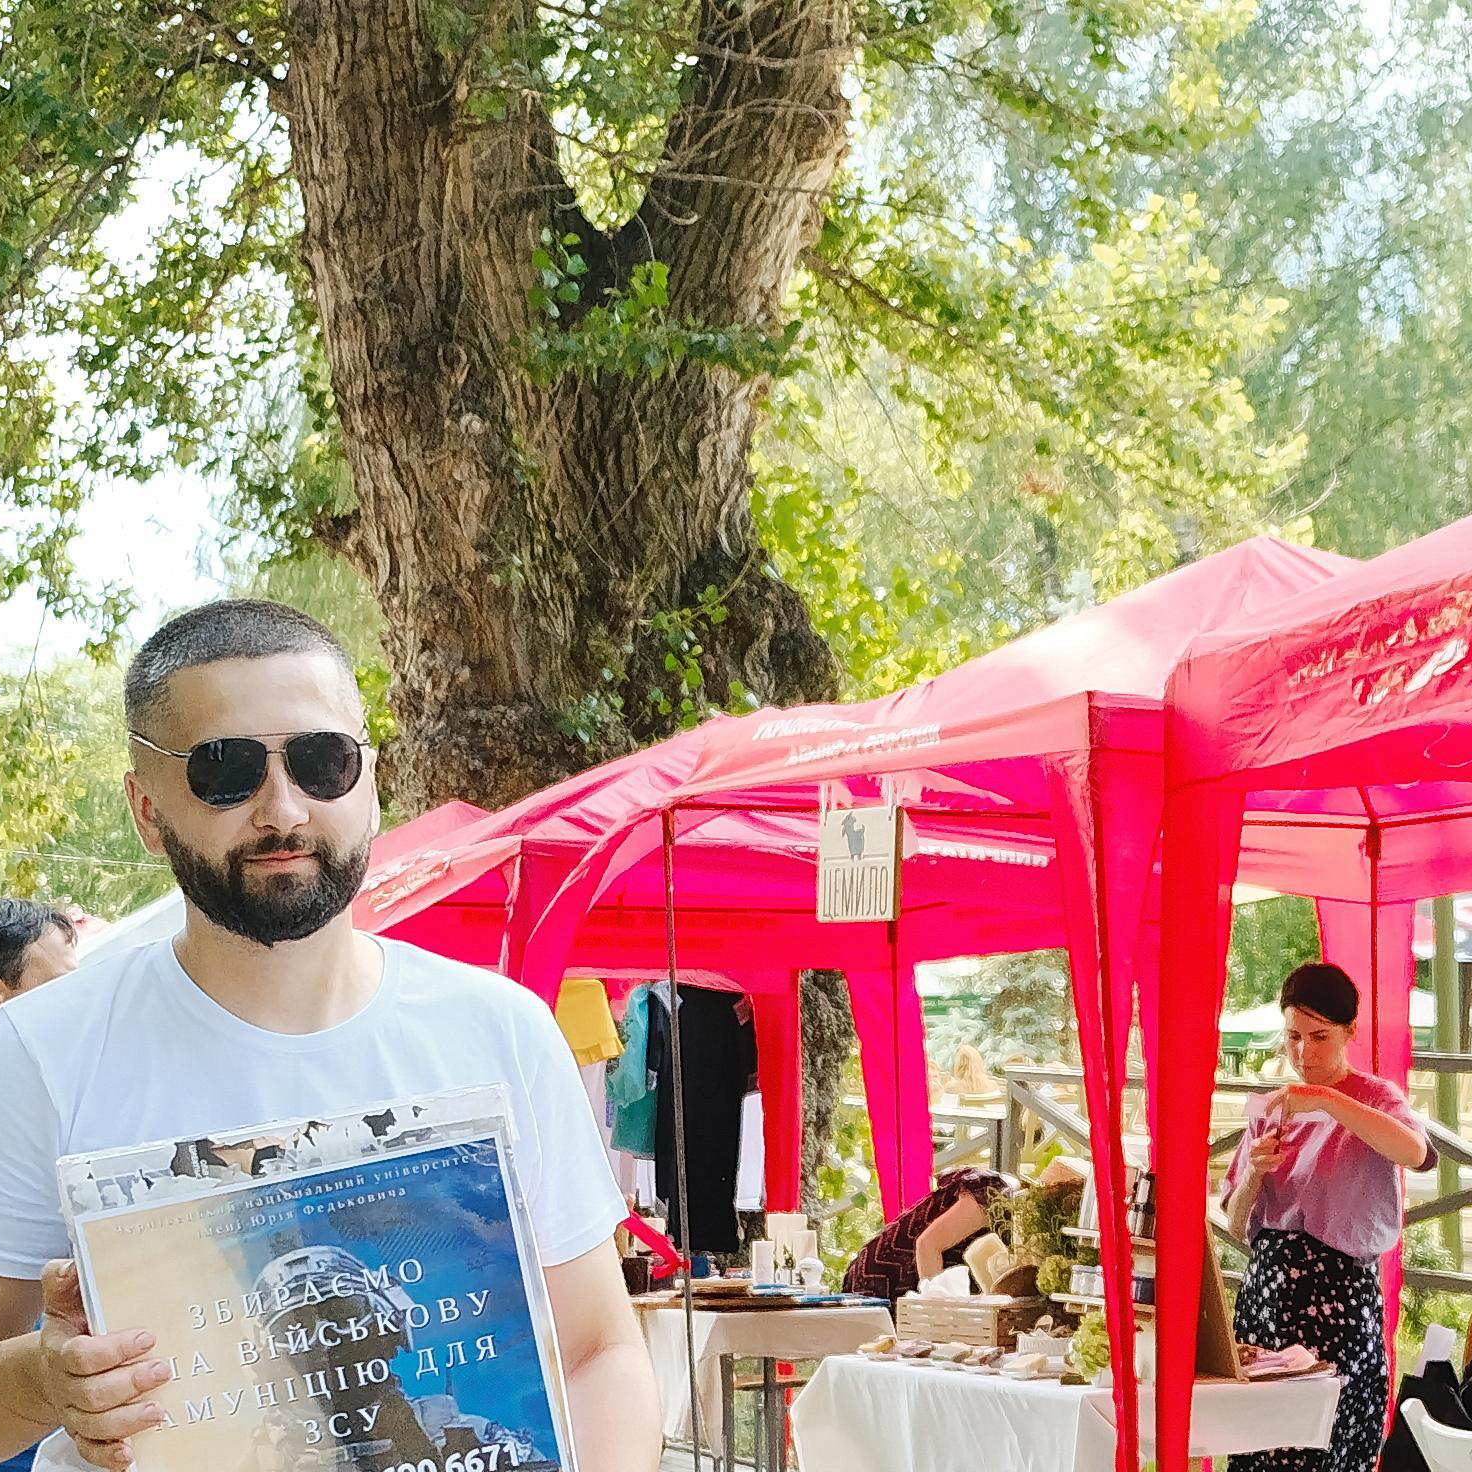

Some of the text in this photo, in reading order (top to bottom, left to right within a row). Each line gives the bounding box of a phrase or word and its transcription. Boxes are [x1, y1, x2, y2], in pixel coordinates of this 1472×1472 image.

[823, 866, 889, 919] ЦЕМИЛО
[250, 1208, 296, 1231] Юрія
[303, 1186, 408, 1218] Федьковича
[187, 1258, 424, 1330] ЗБИРАЄМО
[238, 1289, 492, 1367] ВІЙСЬКОВУ
[415, 1333, 499, 1380] ДЛЯ
[304, 1404, 383, 1445] ЗСУ
